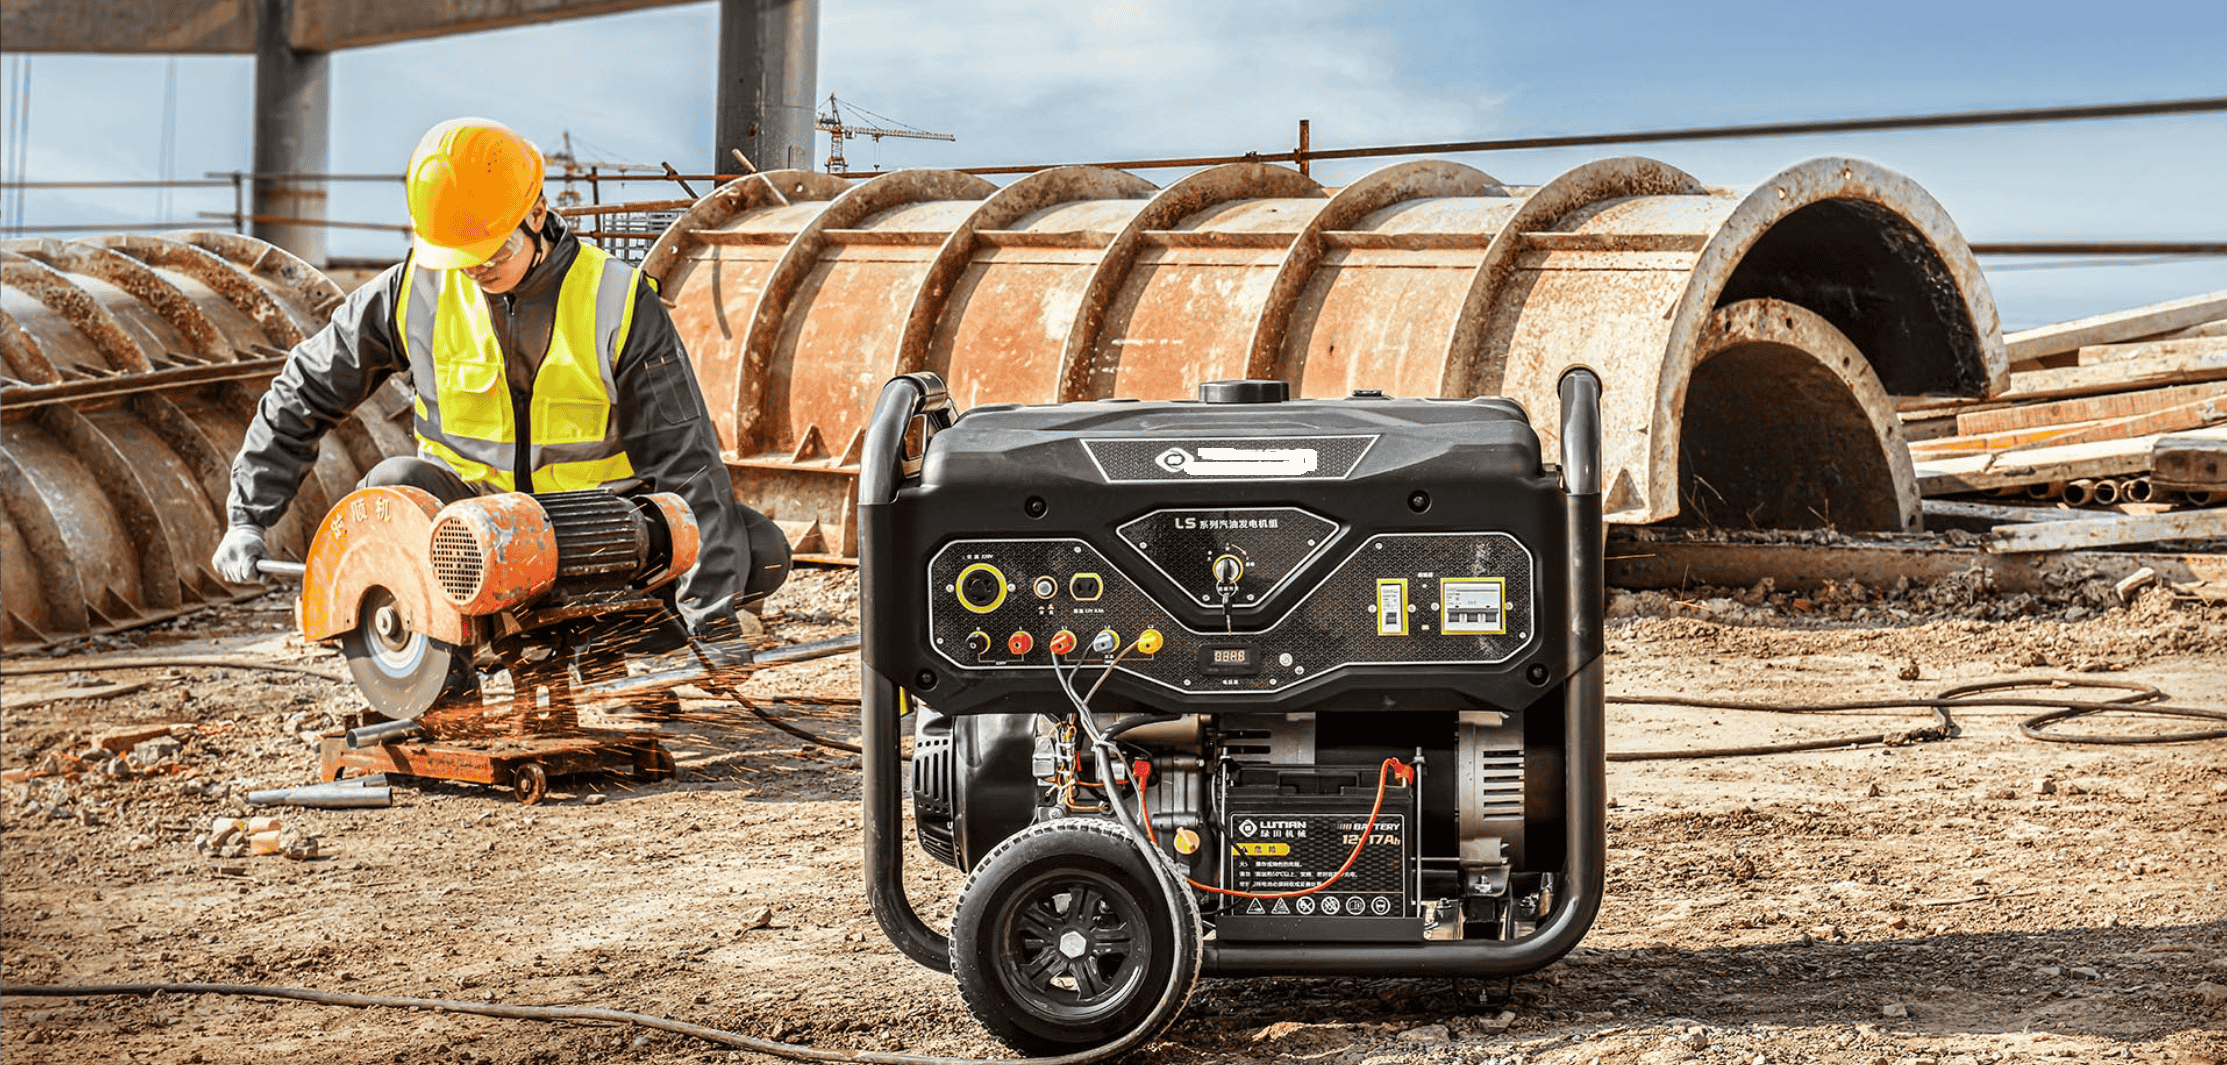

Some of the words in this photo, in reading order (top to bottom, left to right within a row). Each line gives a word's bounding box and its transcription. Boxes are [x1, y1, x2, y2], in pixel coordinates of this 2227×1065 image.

[1175, 517, 1197, 530] LS
[1199, 518, 1279, 530] 系列汽油发电机组
[1260, 821, 1307, 829] LUTIAN
[1353, 823, 1400, 831] BATERY
[1260, 829, 1308, 838] 绿田机械
